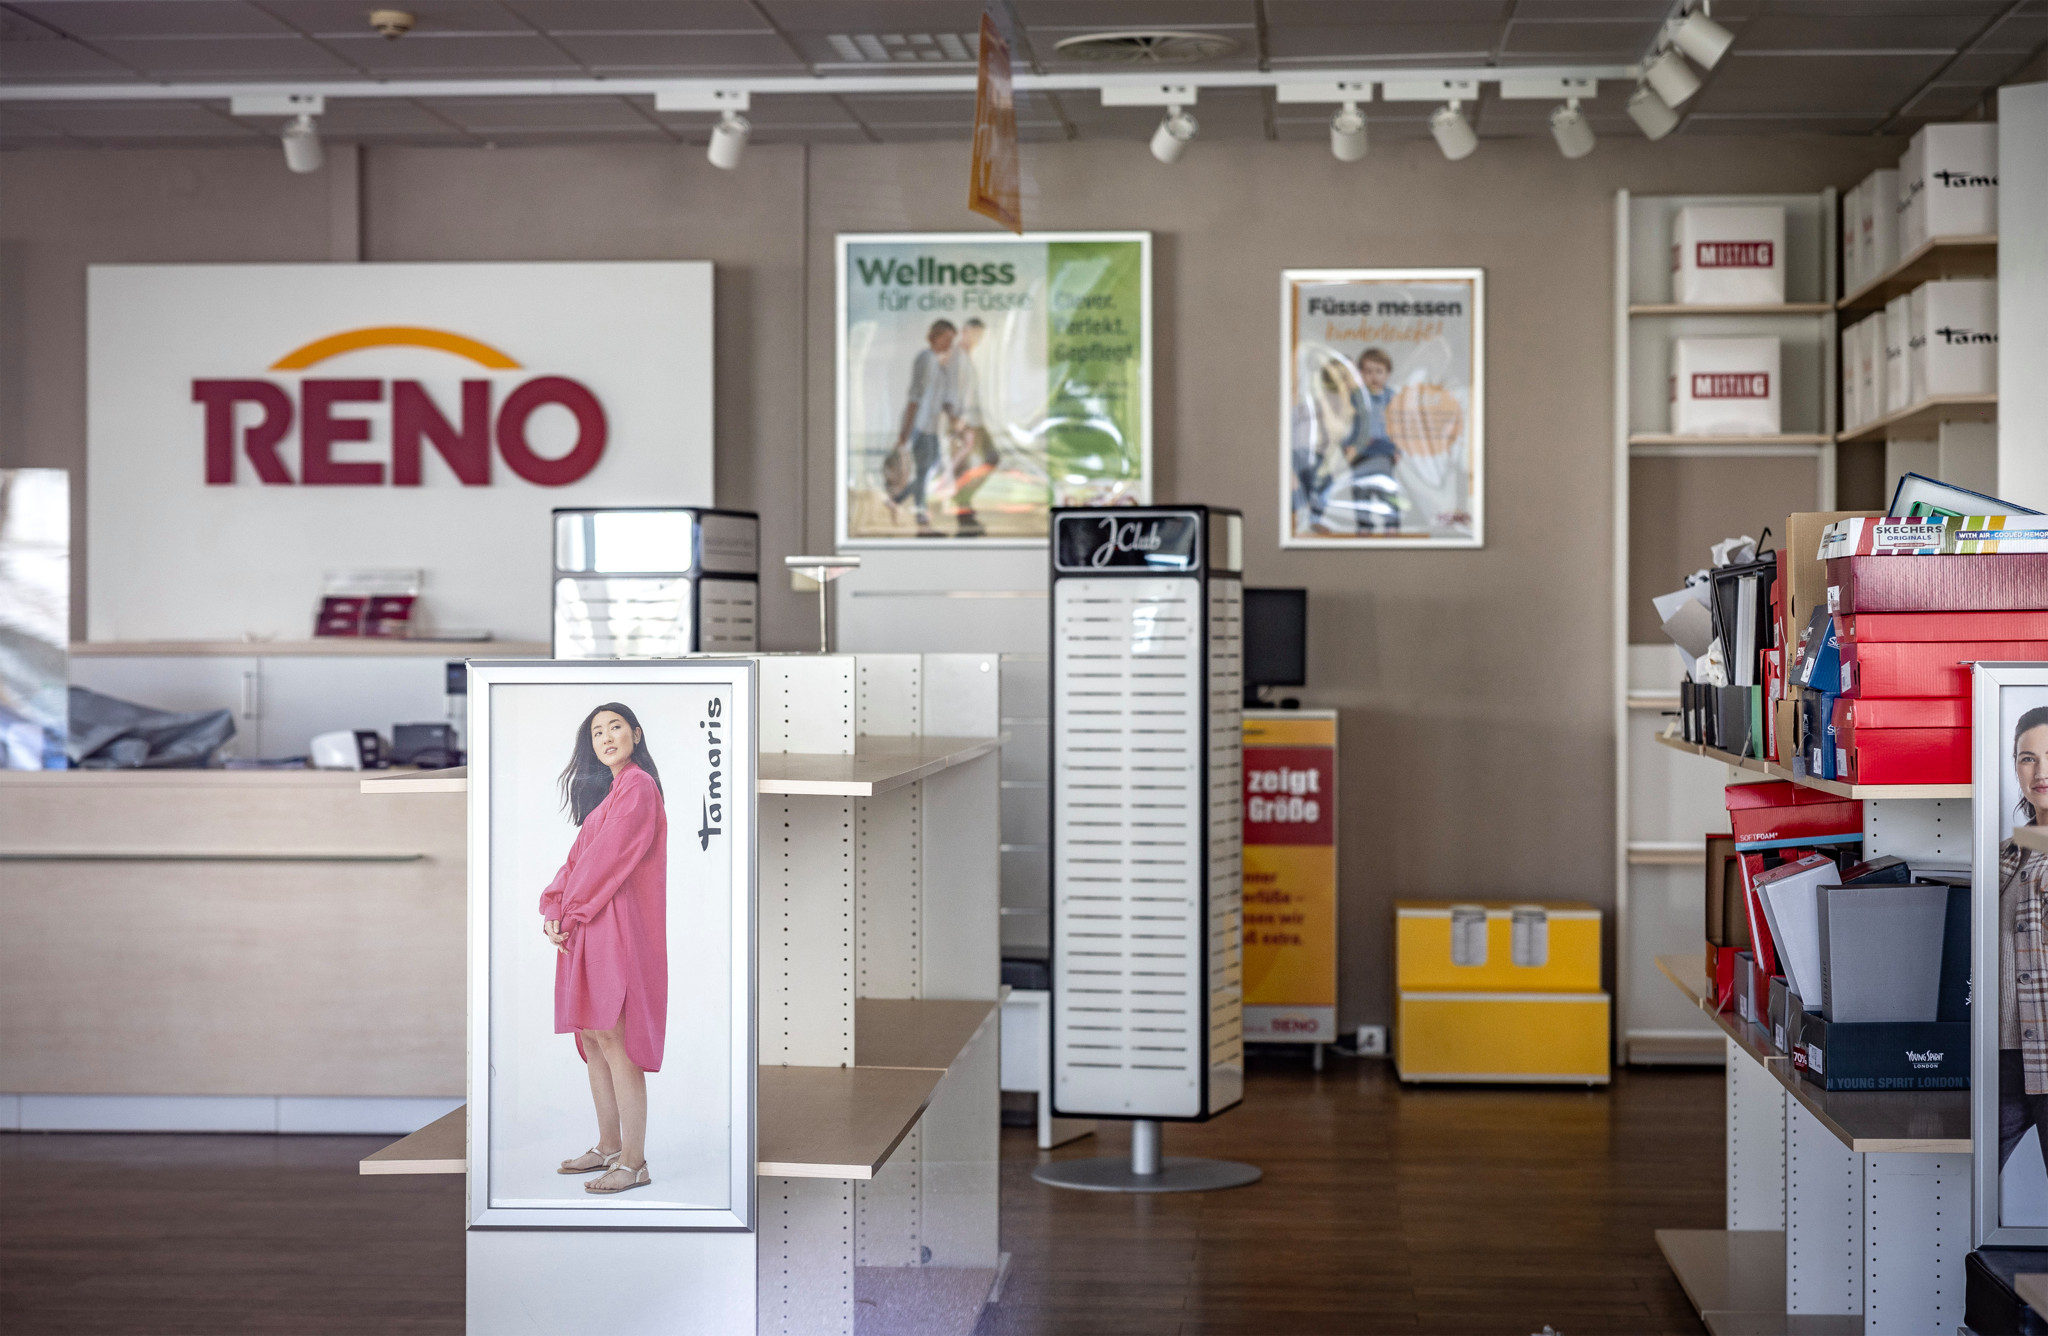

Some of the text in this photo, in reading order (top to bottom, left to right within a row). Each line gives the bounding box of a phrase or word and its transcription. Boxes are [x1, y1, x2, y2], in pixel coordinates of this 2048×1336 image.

[1699, 244, 1770, 266] MUSTANG
[856, 257, 1016, 286] Wellness
[877, 290, 912, 312] für
[917, 289, 956, 312] die
[1308, 295, 1462, 317] Füsse messen
[1694, 374, 1766, 398] MUSTANG
[192, 375, 608, 488] RENO
[1876, 525, 1942, 534] SKECHERS
[697, 697, 722, 852] Tamaris
[1248, 767, 1320, 794] zeigt
[1248, 796, 1320, 823] Größe
[1270, 1017, 1319, 1033] RENO
[1837, 1077, 1875, 1089] YOUNG
[1878, 1077, 1914, 1089] SPIRIT
[1918, 1077, 1964, 1088] LONDON
